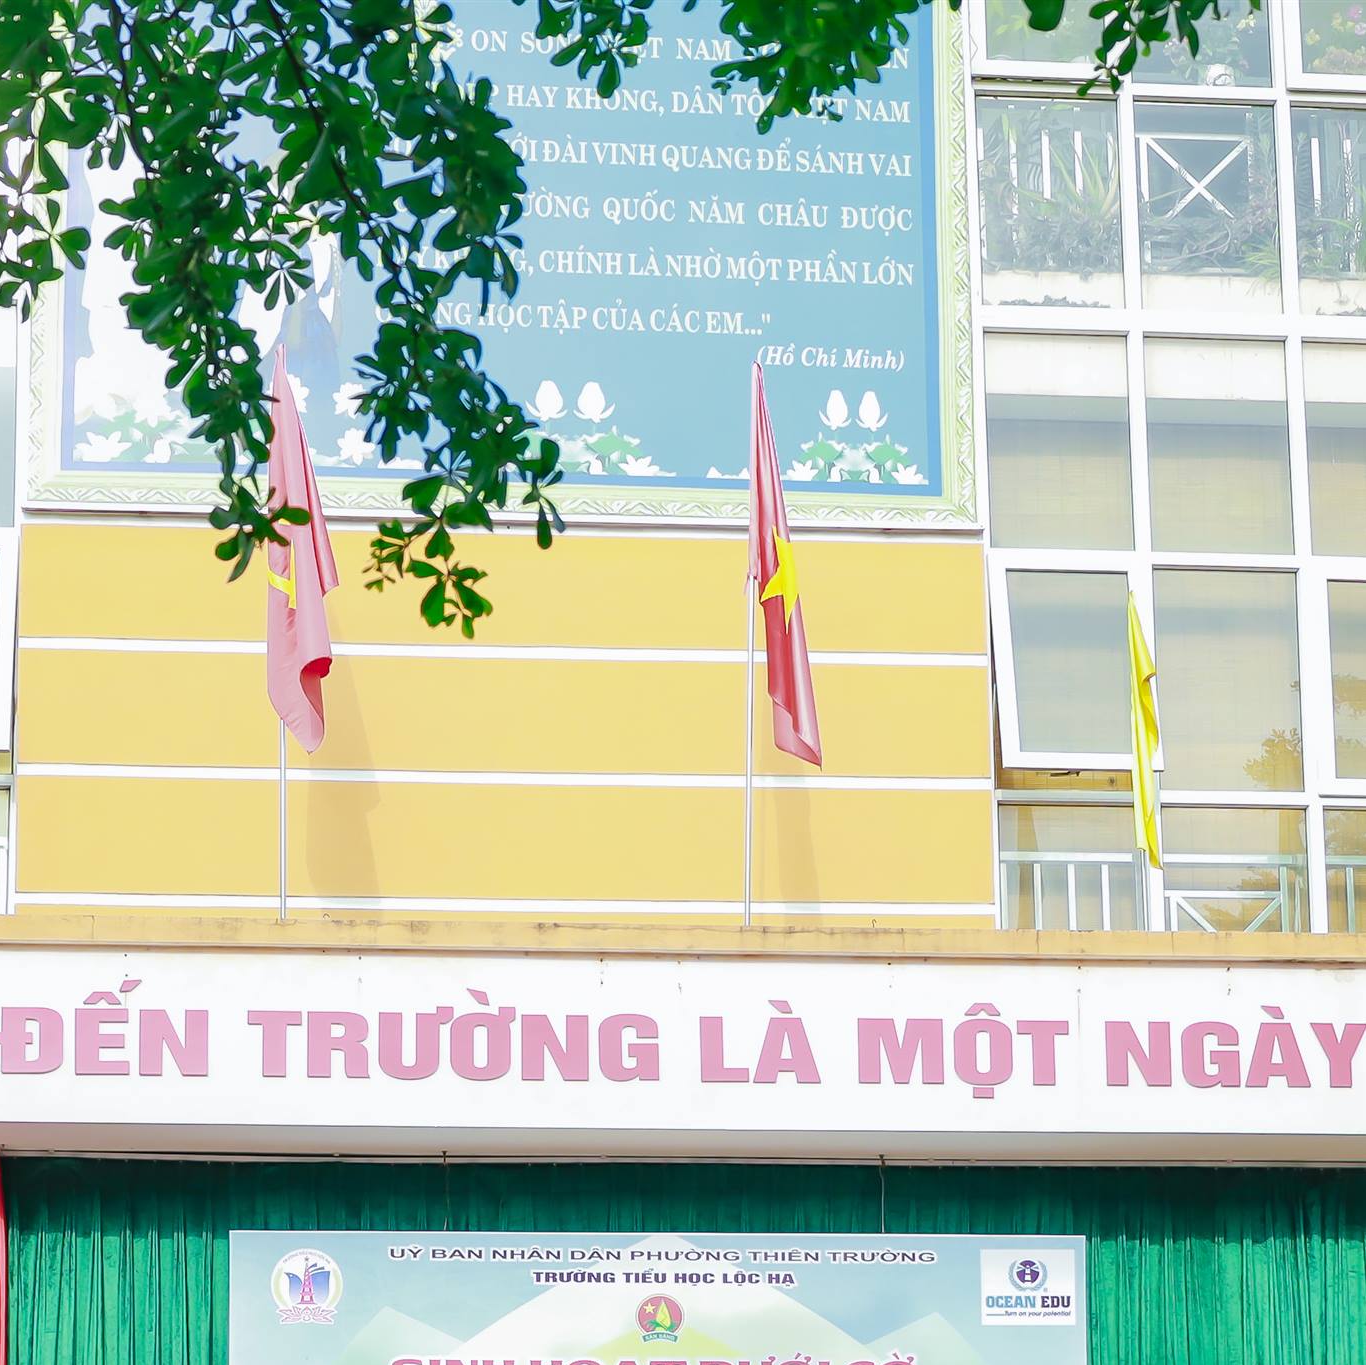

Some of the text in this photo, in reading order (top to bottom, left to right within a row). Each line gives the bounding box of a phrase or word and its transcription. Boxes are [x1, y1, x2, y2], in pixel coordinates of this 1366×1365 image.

[676, 38, 732, 61] NAM
[506, 84, 559, 108] HAY
[671, 85, 723, 115] DÂN
[731, 87, 775, 123] TỘ
[854, 99, 910, 123] NAM
[503, 131, 912, 177] ỚI ĐÀI VINH QUANG ĐỂ SÁNH VAI
[513, 186, 914, 237] ƯỜNG QUỐC NĂM CHÂU ĐƯỢC
[539, 244, 622, 275] CHÍNH
[627, 246, 661, 277] LÀ
[665, 247, 722, 279] NHỜ
[725, 250, 782, 286] MỘT
[787, 249, 857, 284] PHẦN
[862, 256, 914, 286] LỚN
[477, 303, 532, 333] HỌC
[537, 299, 588, 335] TẬP
[592, 299, 646, 332] CỦA
[649, 304, 700, 333] CÁC
[756, 343, 905, 372] (Hồ Chí Minh)
[246, 988, 660, 1082] TRƯỜNG
[698, 999, 822, 1085] LÀ
[857, 1002, 1070, 1100] MỘT
[432, 1248, 483, 1259] BAN
[492, 1246, 562, 1260] NHÂN
[570, 1247, 621, 1261] DÂN
[630, 1247, 740, 1262] PHƯỜNG
[748, 1248, 819, 1262] THIÊN
[827, 1249, 936, 1263] TRƯỜNG
[533, 1268, 795, 1287] TRƯỜNG TIỂU HỌC LỘC HẠ
[986, 1295, 1071, 1308] OCEAN EDU
